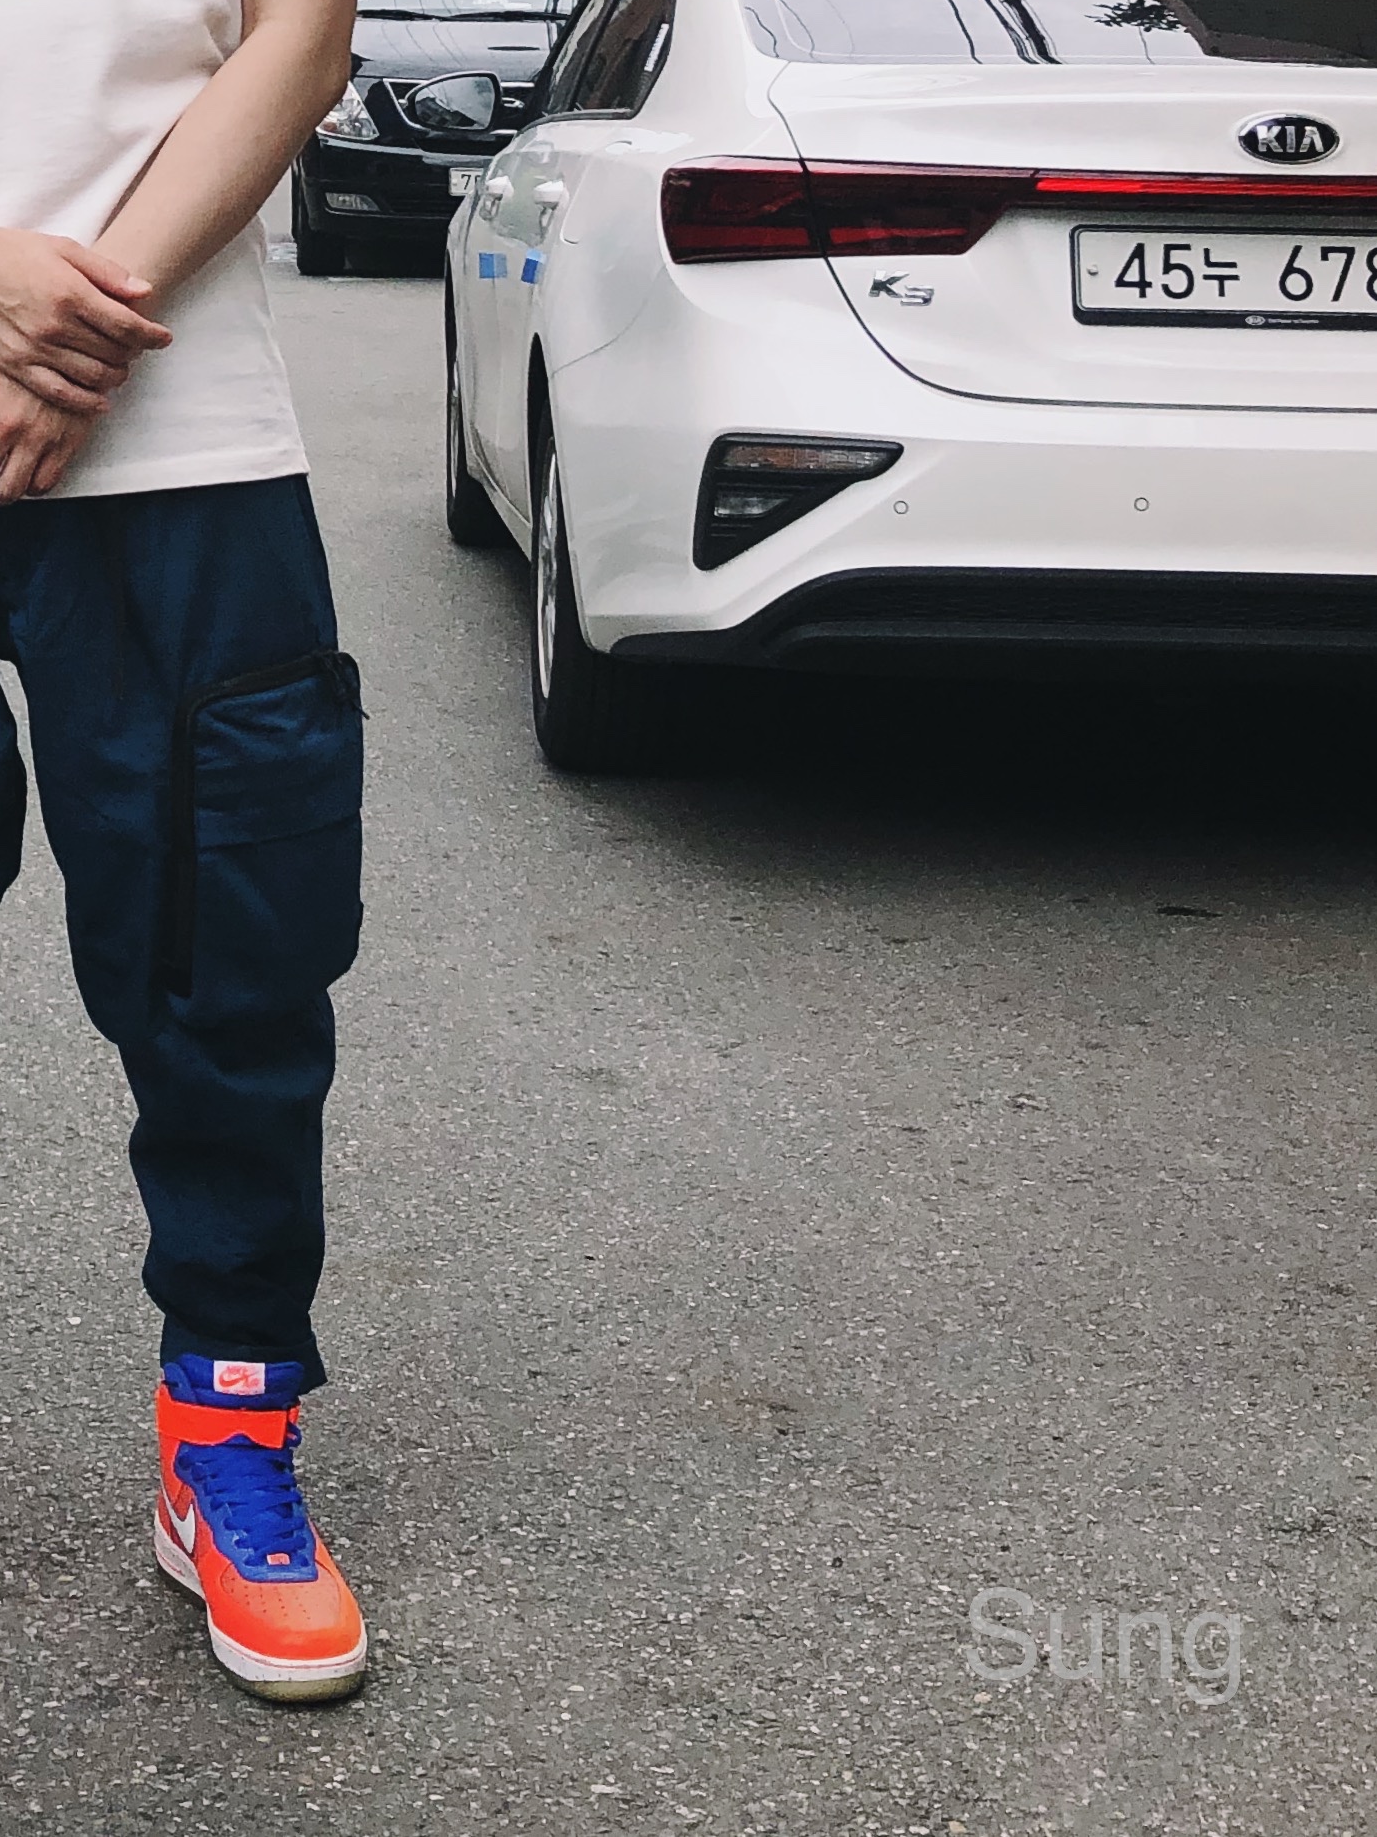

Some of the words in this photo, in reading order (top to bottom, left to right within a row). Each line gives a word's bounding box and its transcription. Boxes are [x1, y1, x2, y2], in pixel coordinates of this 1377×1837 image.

[1256, 124, 1325, 154] KIA
[868, 270, 934, 306] K5
[1114, 242, 1241, 299] 45누
